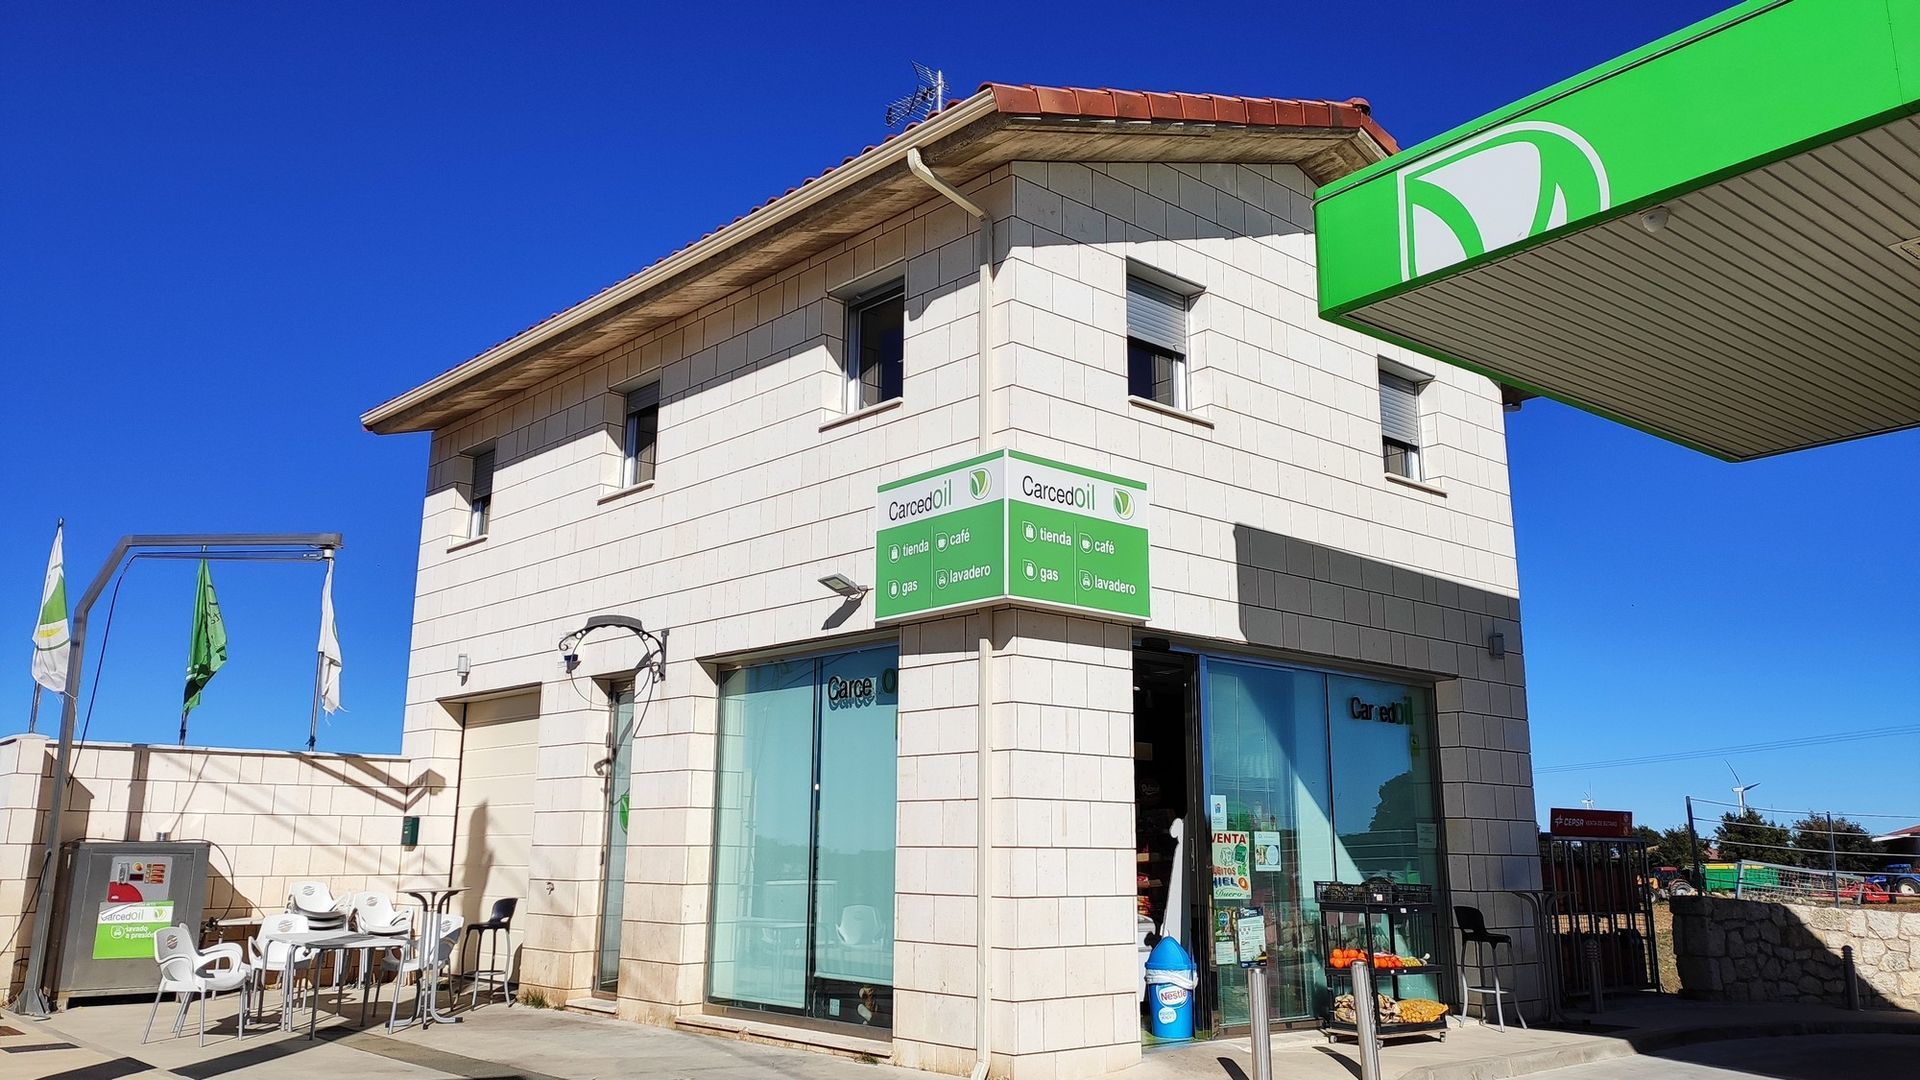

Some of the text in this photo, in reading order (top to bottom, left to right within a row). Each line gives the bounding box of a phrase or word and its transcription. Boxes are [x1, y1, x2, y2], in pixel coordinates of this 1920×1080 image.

[888, 478, 952, 521] CarcedOil
[1022, 475, 1095, 511] CarcedOil
[950, 527, 970, 546] café
[1039, 528, 1072, 546] tienda
[902, 539, 929, 557] tienda
[1094, 539, 1115, 555] café
[950, 565, 991, 583] lavadero
[1040, 567, 1059, 583] gas
[901, 578, 918, 597] gas
[1094, 577, 1136, 595] lavadero
[1212, 833, 1247, 844] VENTA
